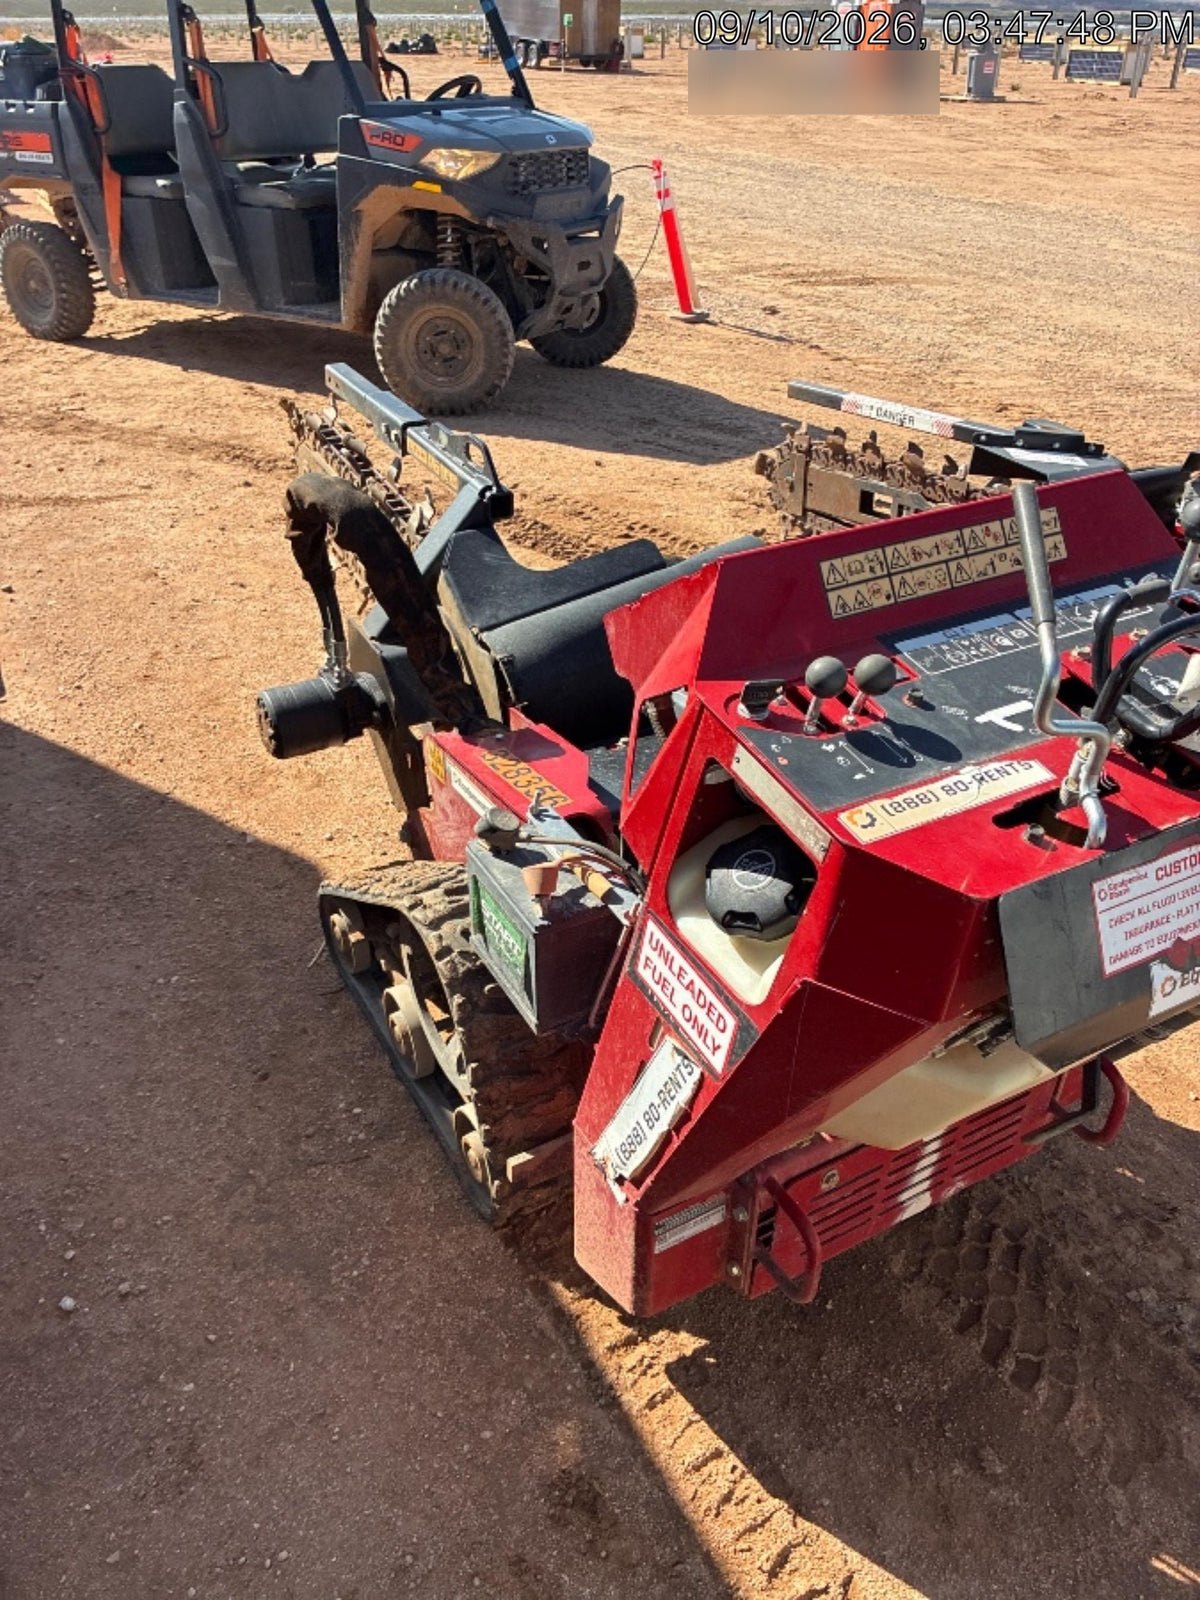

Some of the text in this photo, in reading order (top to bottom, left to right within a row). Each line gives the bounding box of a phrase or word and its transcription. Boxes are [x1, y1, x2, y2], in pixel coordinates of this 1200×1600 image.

[876, 407, 915, 426] DANGER
[880, 760, 1033, 816] (888) 80-RENTS
[1155, 853, 1200, 882] CUSTO
[643, 956, 722, 1057] FUEL ONLY
[648, 931, 727, 1034] UNLEADED
[614, 1058, 695, 1167] (888) 80-RENTS
